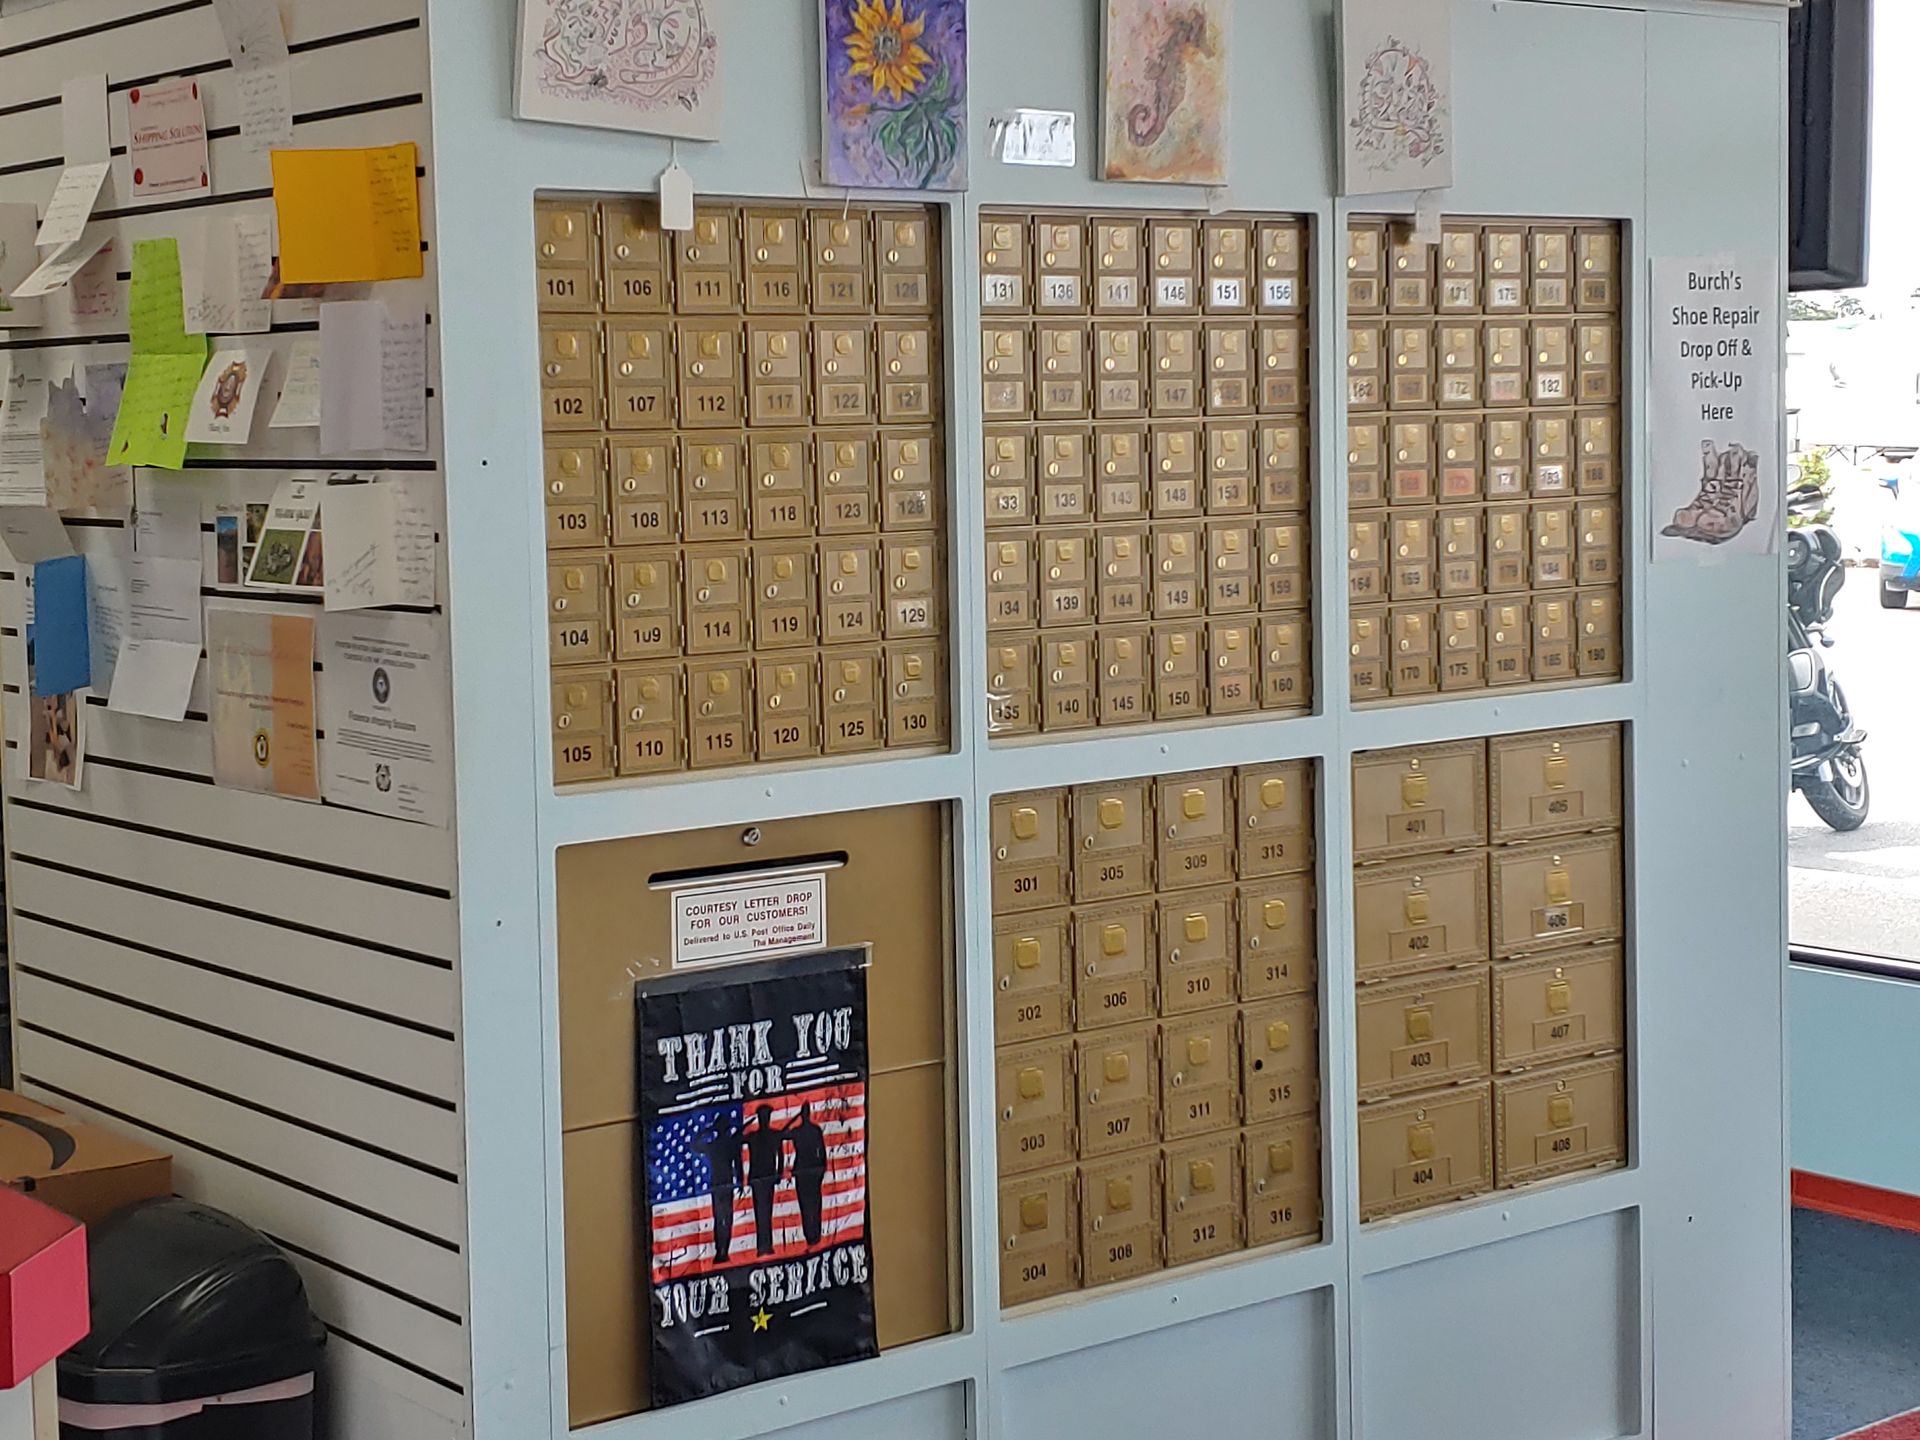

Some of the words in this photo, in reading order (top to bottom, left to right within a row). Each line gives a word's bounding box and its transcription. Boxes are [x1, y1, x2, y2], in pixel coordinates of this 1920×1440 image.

[547, 280, 575, 296] 101
[624, 280, 652, 295] 106
[1688, 270, 1741, 291] Burch's
[695, 282, 721, 296] 111
[765, 282, 790, 297] 116
[830, 282, 854, 297] 121
[992, 282, 1014, 298] 131
[1051, 284, 1073, 299] 136
[1108, 285, 1129, 300] 141
[1164, 286, 1185, 301] 146
[1217, 285, 1237, 300] 151
[1270, 286, 1290, 299] 156
[1672, 306, 1708, 325] Shoe
[1714, 306, 1759, 328] Repair
[1680, 341, 1712, 361] Drop
[1717, 339, 1737, 357] Off
[1741, 340, 1752, 356] &
[1540, 379, 1559, 392] 182
[1691, 371, 1742, 391] Pick-Up
[554, 398, 583, 414] 102
[628, 397, 656, 412] 107
[698, 397, 726, 411] 112
[768, 395, 793, 409] 117
[834, 394, 859, 409] 122
[1701, 404, 1733, 420] Here
[1054, 494, 1076, 508] 138
[1165, 488, 1186, 502] 148
[702, 510, 728, 525] 113
[770, 507, 797, 522] 118
[836, 504, 861, 519] 123
[558, 514, 587, 530] 103
[631, 512, 658, 528] 108
[1219, 584, 1240, 598] 154
[1271, 581, 1290, 594] 159
[1056, 596, 1078, 610] 139
[1111, 594, 1133, 608] 144
[1167, 590, 1188, 605] 149
[901, 609, 925, 623] 129
[999, 601, 1019, 616] 134
[772, 618, 798, 633] 119
[838, 612, 863, 628] 124
[704, 622, 730, 638] 114
[560, 630, 588, 646] 104
[1588, 649, 1605, 661] 190
[1400, 667, 1419, 679] 170
[1450, 663, 1468, 675] 175
[1497, 659, 1516, 672] 180
[1272, 678, 1293, 692] 160
[1353, 673, 1372, 686] 165
[1169, 692, 1190, 705] 150
[1220, 684, 1241, 698] 155
[1057, 699, 1079, 714] 140
[1113, 696, 1133, 711] 145
[839, 721, 864, 737] 125
[902, 715, 926, 730] 130
[706, 734, 733, 749] 115
[774, 728, 799, 744] 120
[562, 747, 592, 762] 105
[636, 741, 663, 756] 110
[1549, 800, 1567, 813] 405
[1406, 820, 1426, 832] 401
[1261, 844, 1283, 858] 313
[1185, 855, 1207, 869] 309
[1100, 866, 1123, 880] 305
[1014, 878, 1037, 892] 301
[686, 901, 738, 916] COURTESY
[744, 896, 779, 909] LETTER
[786, 892, 812, 904] DROP
[690, 918, 710, 930] FOR
[719, 914, 739, 926] OUR
[747, 906, 808, 922] CUSTOMERS!
[1548, 914, 1566, 927] 406
[684, 932, 718, 946] Delivered
[722, 932, 730, 940] to
[752, 927, 768, 936] Post
[772, 924, 794, 934] Office
[798, 921, 815, 932] Daily
[753, 938, 766, 948] The
[768, 932, 814, 946] Management
[1409, 936, 1429, 950] 402
[1266, 965, 1287, 980] 314
[1187, 978, 1210, 993] 310
[1103, 993, 1127, 1008] 306
[1017, 1006, 1041, 1022] 302
[1551, 1026, 1569, 1038] 407
[657, 1019, 774, 1083] THANK
[792, 1007, 852, 1059] YOU
[1411, 1053, 1431, 1066] 403
[731, 1067, 784, 1099] FOR
[1269, 1086, 1290, 1101] 315
[1189, 1102, 1210, 1118] 311
[1107, 1119, 1130, 1134] 307
[1021, 1134, 1045, 1150] 303
[1552, 1138, 1570, 1152] 408
[1413, 1169, 1433, 1183] 404
[1271, 1208, 1291, 1223] 316
[1193, 1226, 1215, 1241] 312
[1109, 1245, 1132, 1262] 308
[1022, 1264, 1046, 1280] 304
[657, 1275, 729, 1328] YOUR
[749, 1244, 868, 1307] SERVICE
